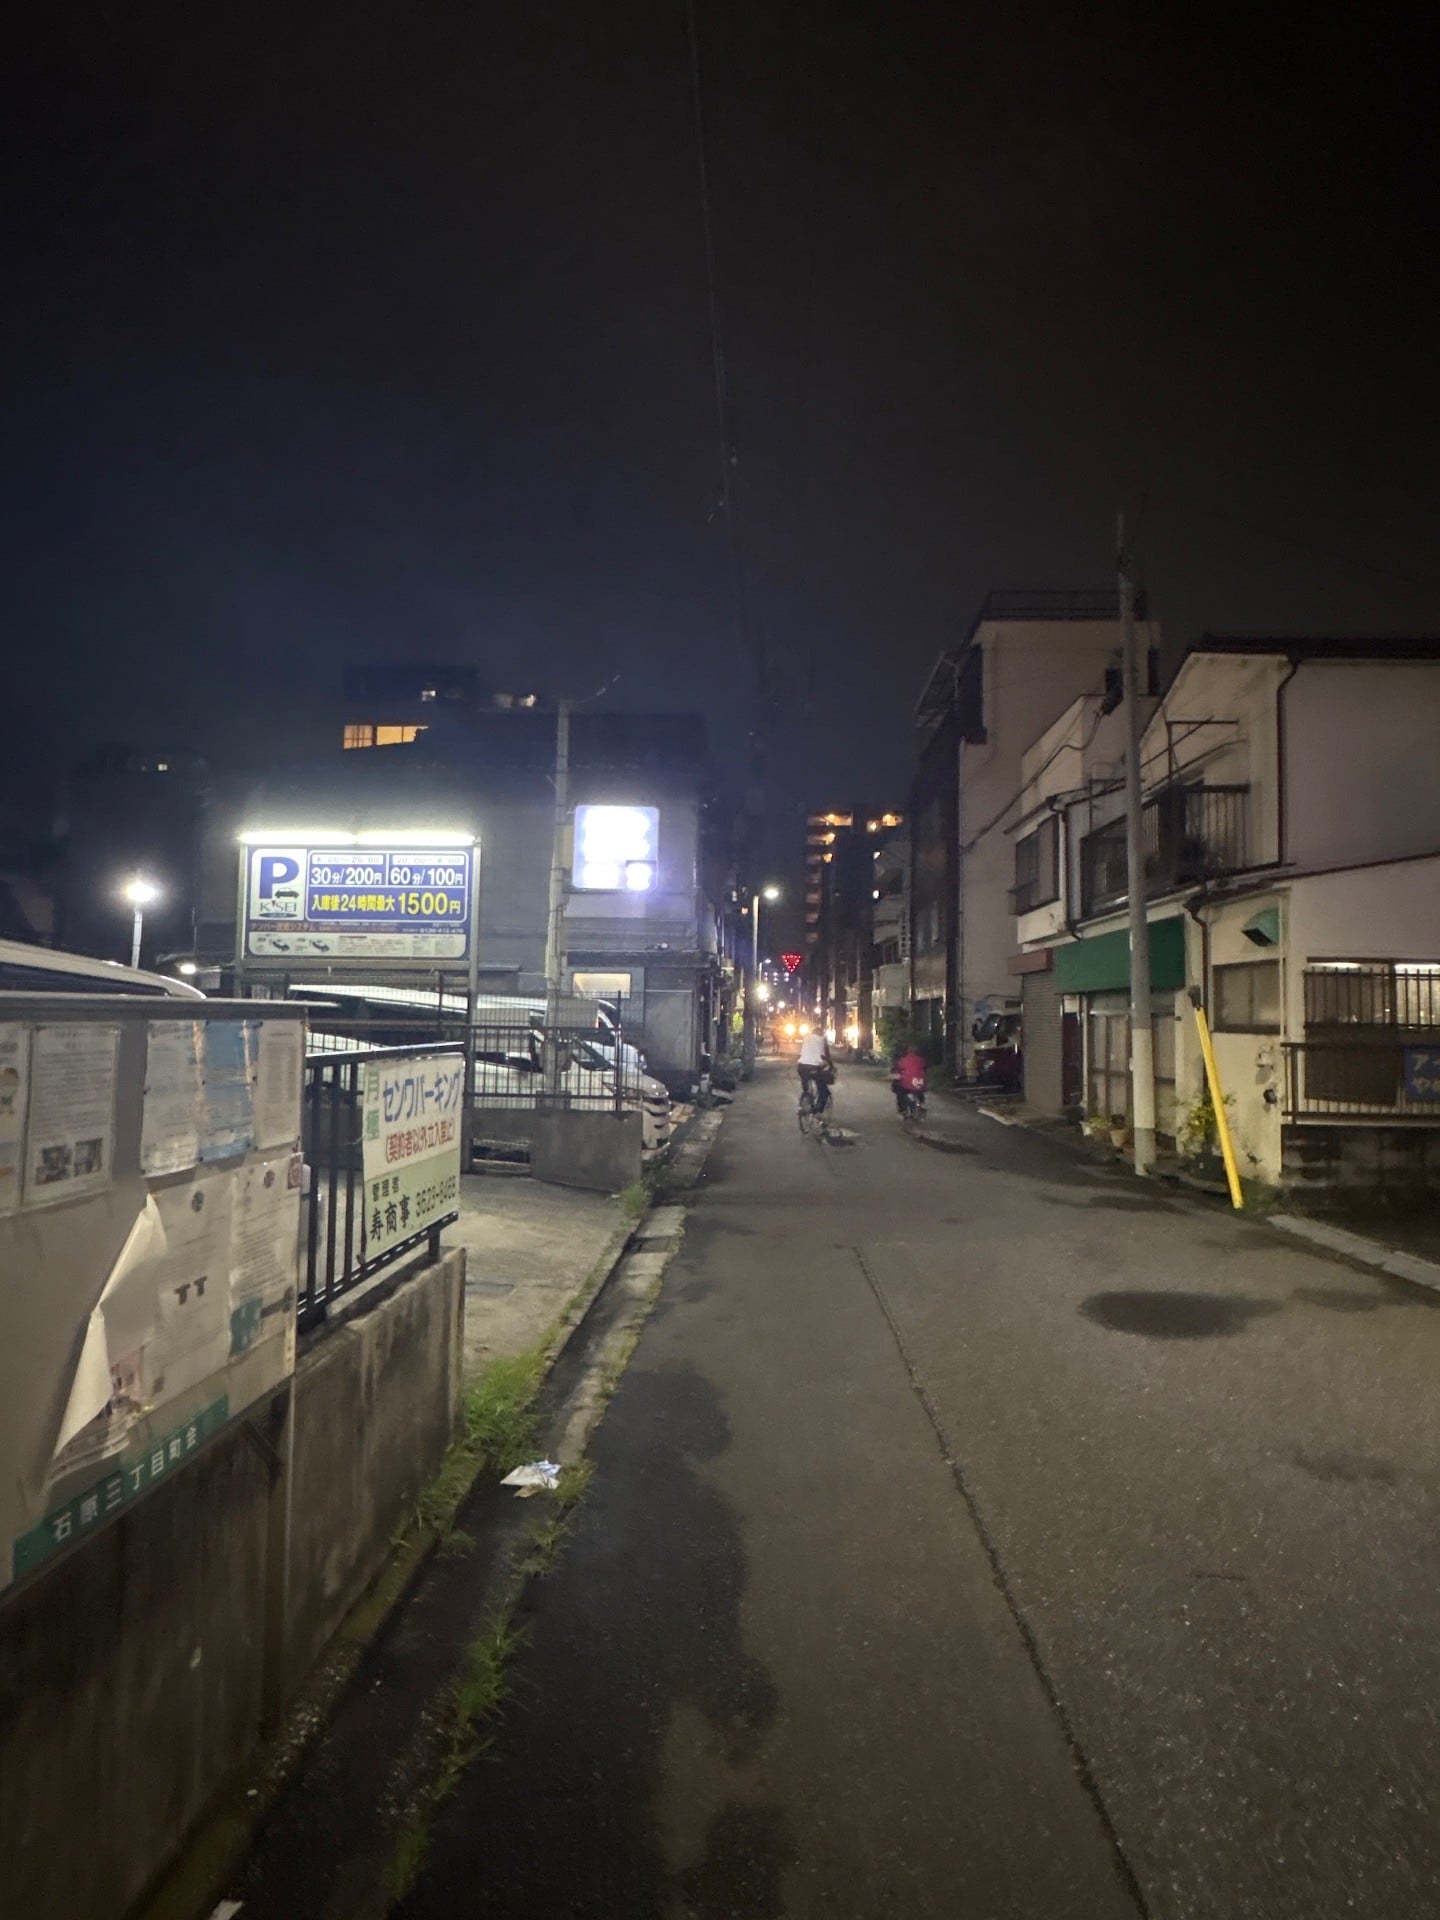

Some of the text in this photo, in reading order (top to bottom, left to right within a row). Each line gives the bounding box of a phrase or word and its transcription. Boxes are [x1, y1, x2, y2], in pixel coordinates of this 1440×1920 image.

[259, 857, 299, 899] P
[311, 866, 382, 886] 30分/200円
[390, 867, 463, 887] 60分/100円
[370, 1194, 411, 1241] 寿商事
[52, 1426, 199, 1543] 石原三丁目町会
